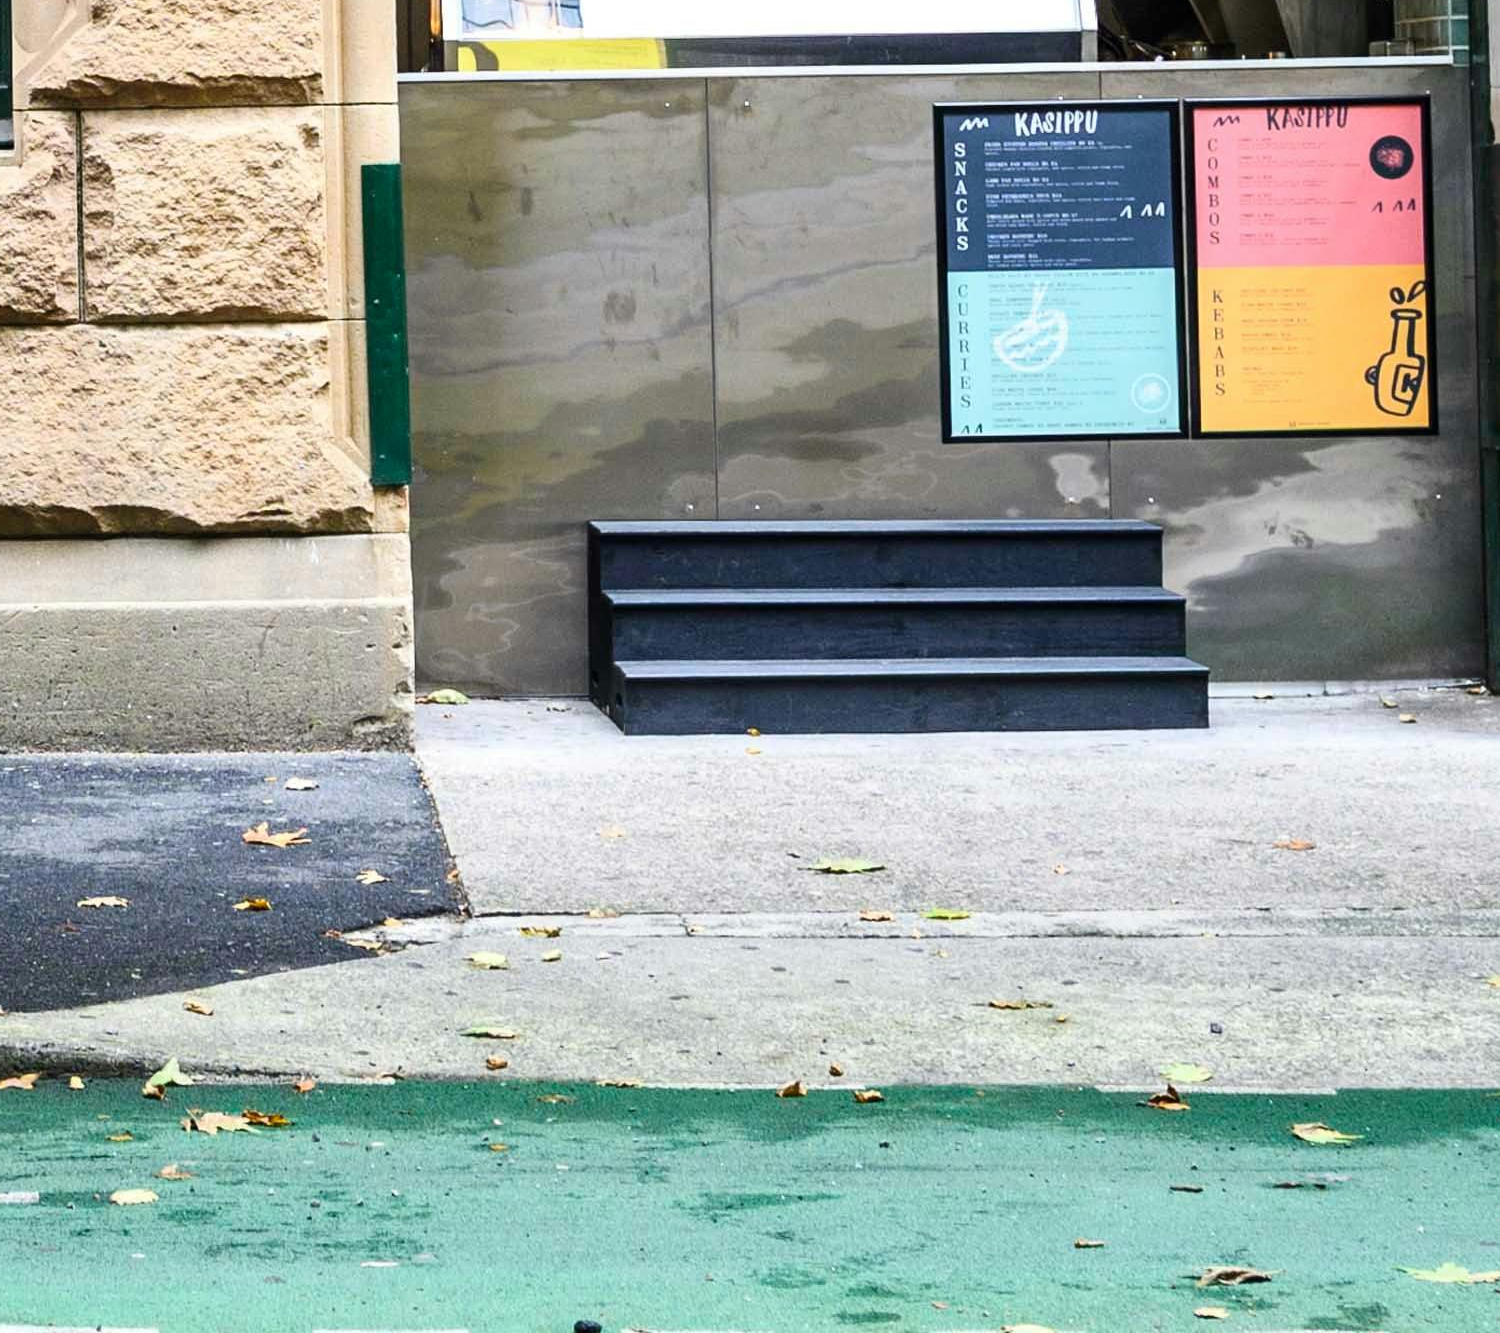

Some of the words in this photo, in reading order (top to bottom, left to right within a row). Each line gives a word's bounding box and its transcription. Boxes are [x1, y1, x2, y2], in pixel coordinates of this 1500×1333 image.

[1015, 110, 1098, 137] KASIPPU
[1266, 106, 1348, 130] KASIPPU
[954, 142, 969, 251] SNACKS
[1207, 139, 1220, 245] COMBOS
[957, 284, 971, 408] CURRIES
[1212, 289, 1226, 396] KEBABS
